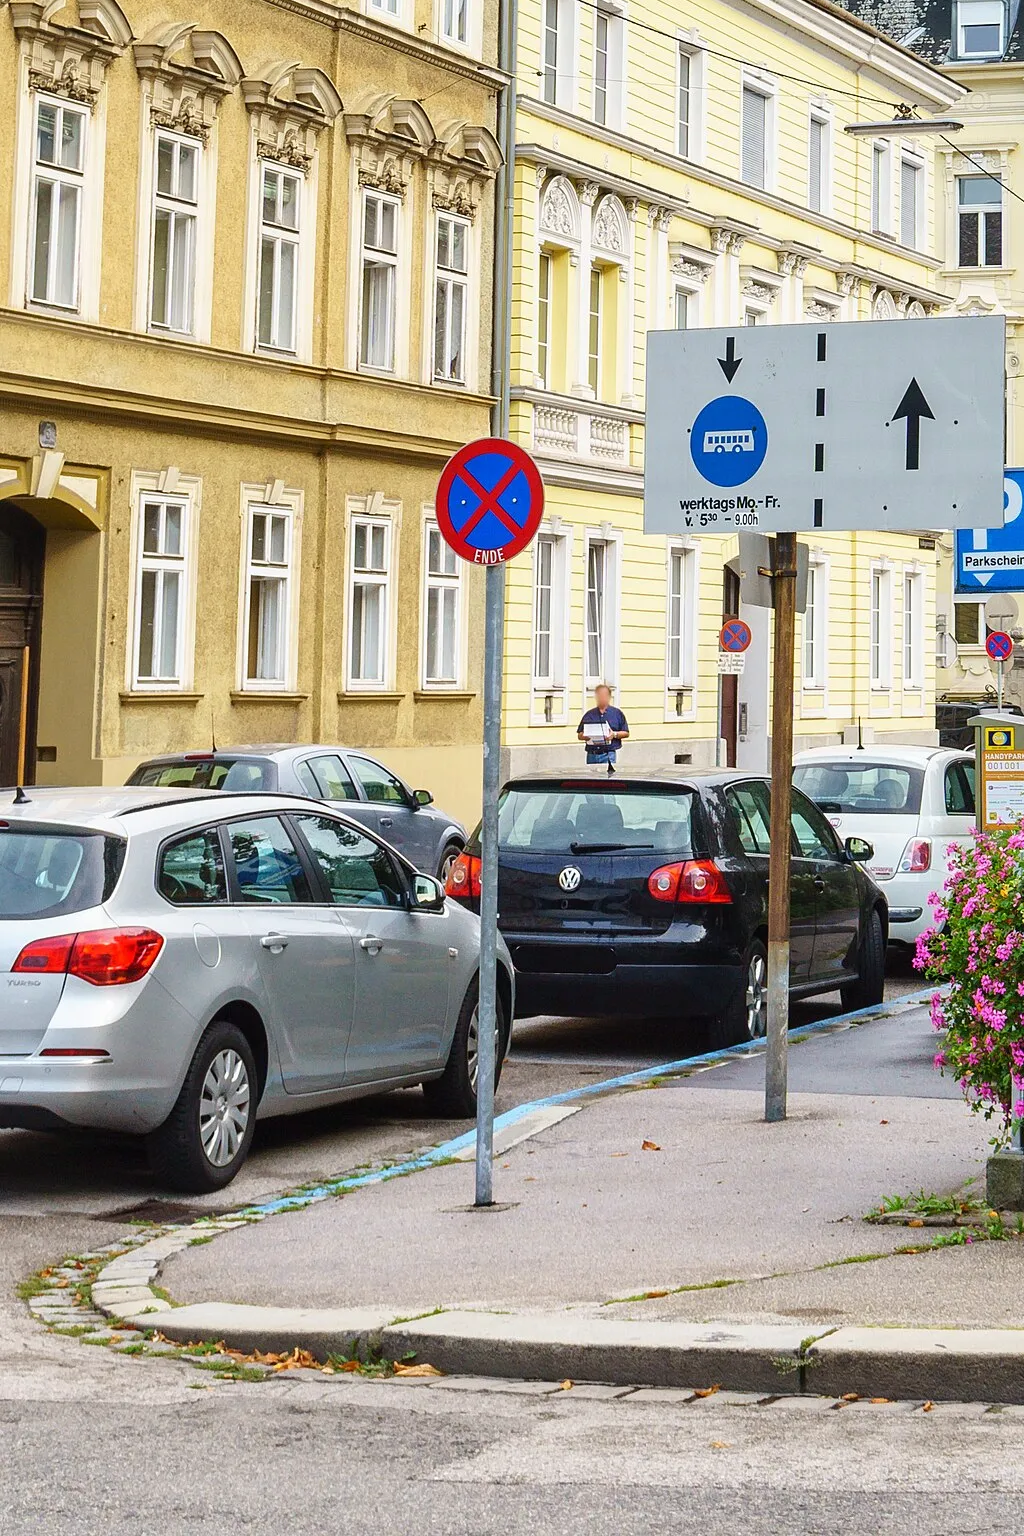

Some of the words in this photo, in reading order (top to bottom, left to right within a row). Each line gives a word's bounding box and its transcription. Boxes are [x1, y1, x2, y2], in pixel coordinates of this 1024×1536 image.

[680, 497, 735, 512] werktags
[685, 516, 694, 526] v.
[735, 514, 758, 525] 9.00h
[474, 548, 505, 563] ENDE
[987, 762, 1020, 770] 001001
